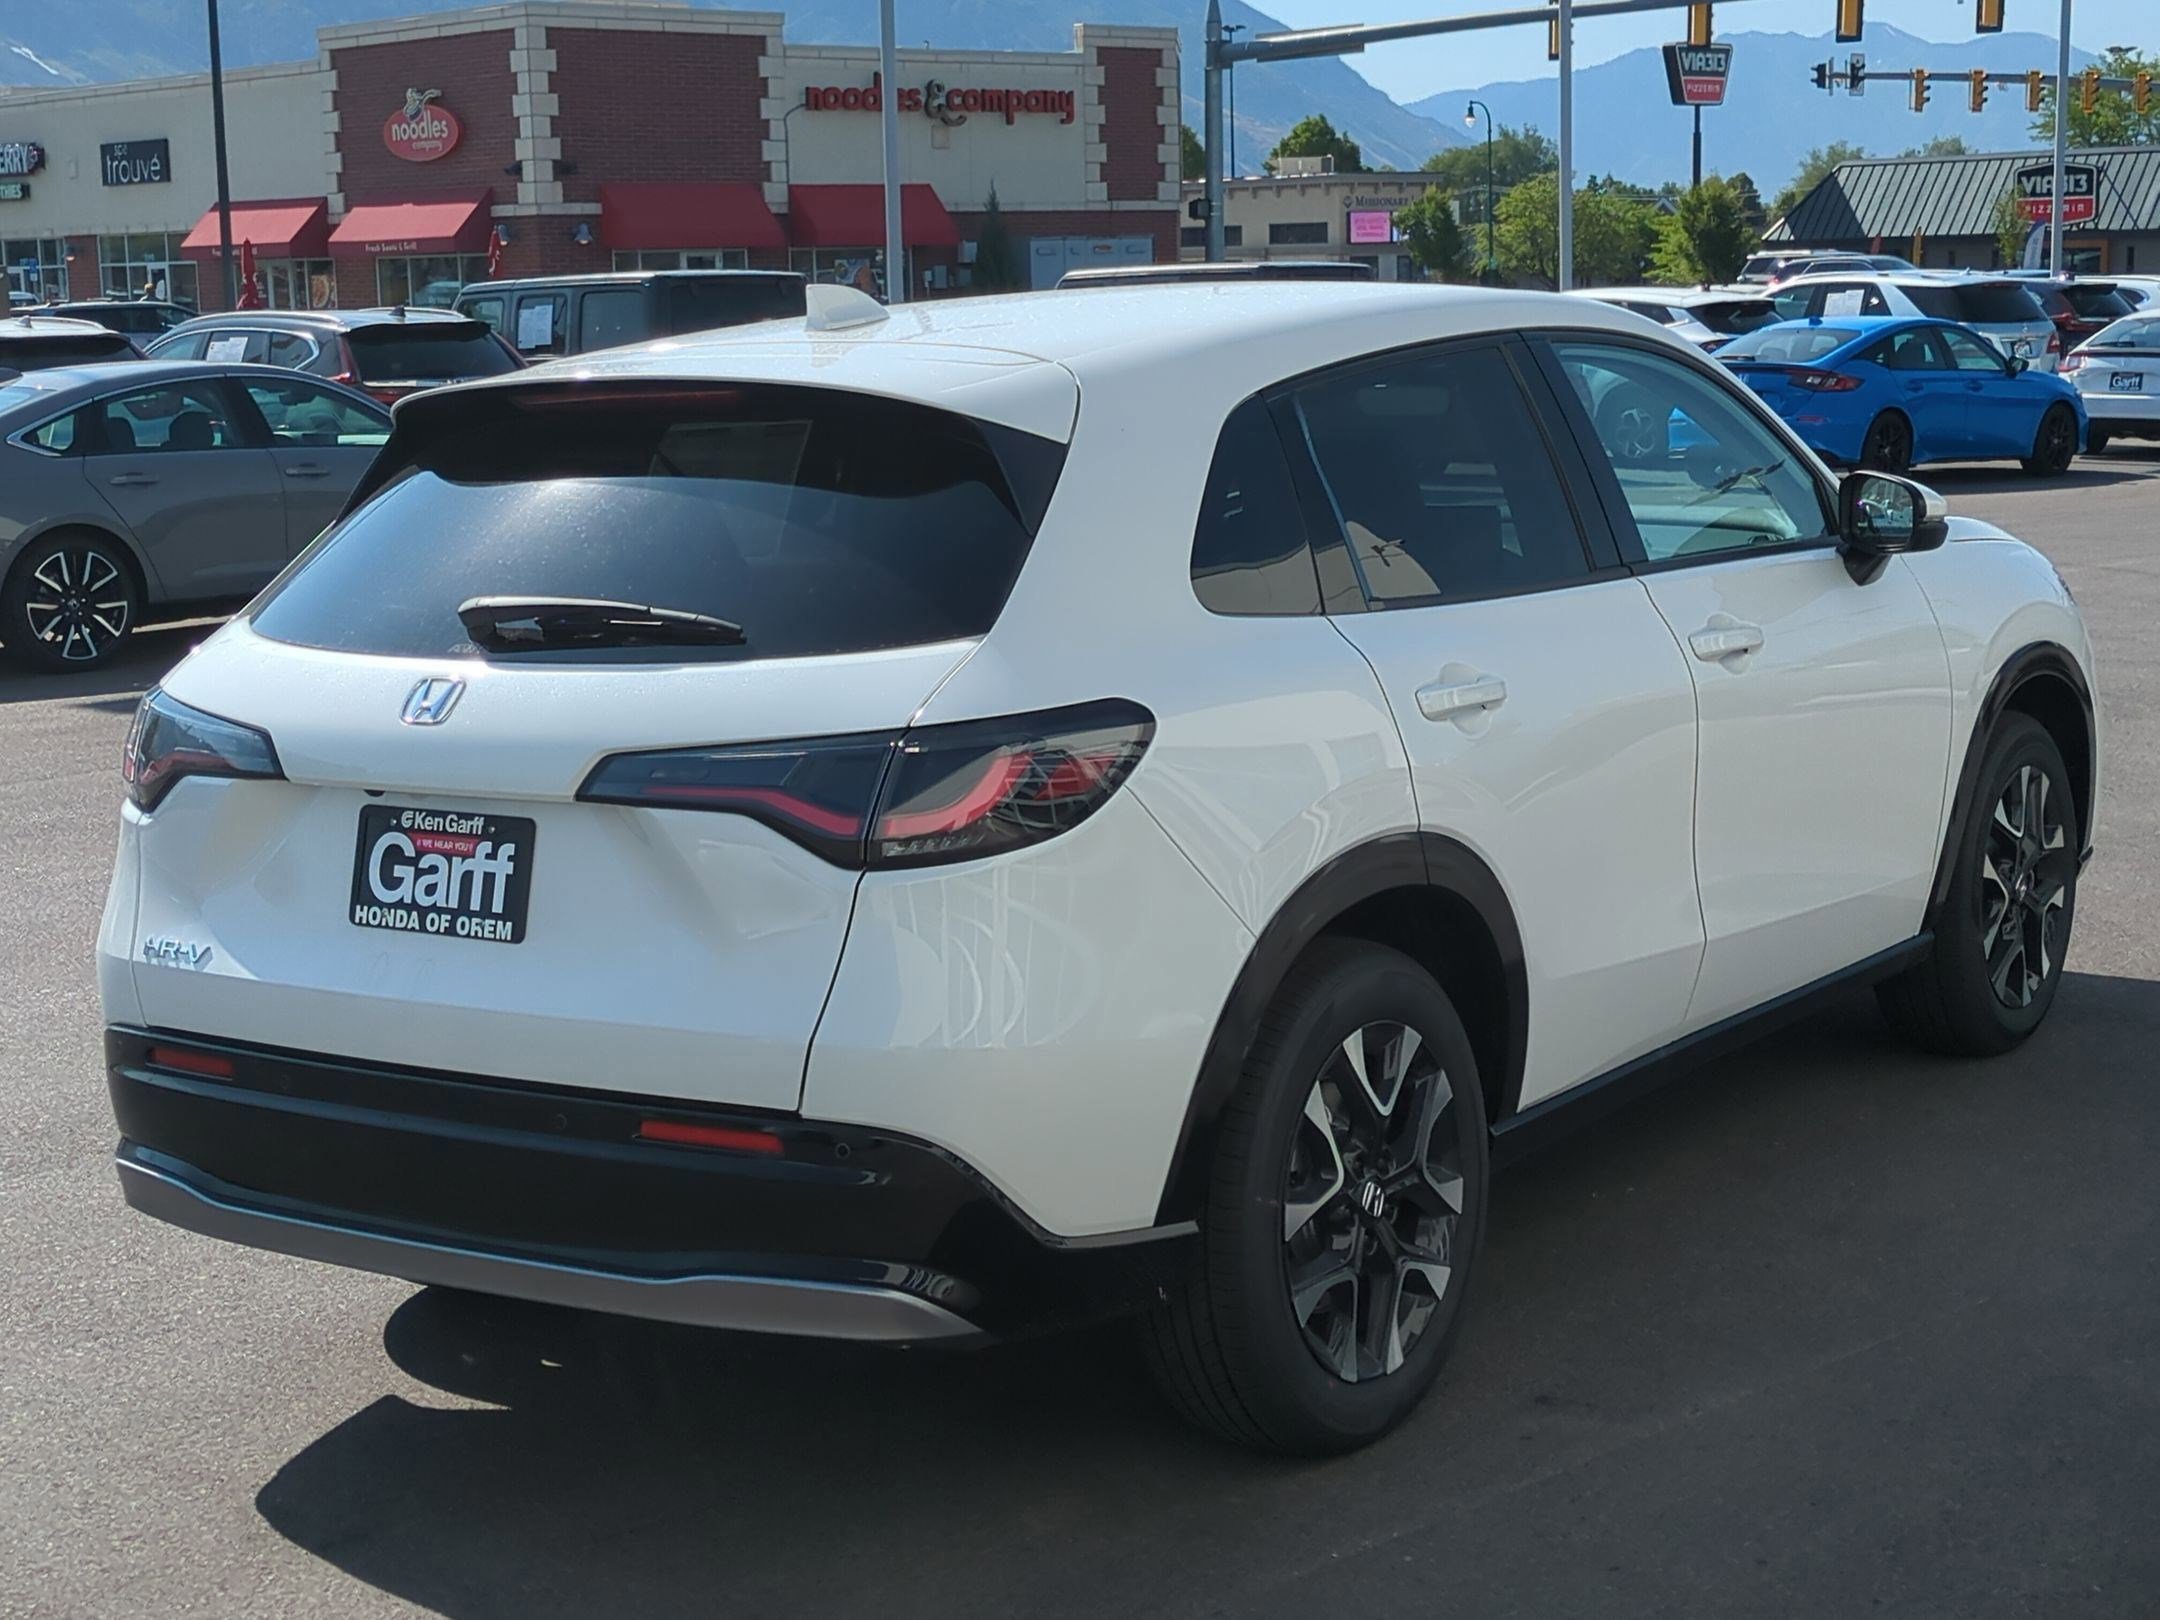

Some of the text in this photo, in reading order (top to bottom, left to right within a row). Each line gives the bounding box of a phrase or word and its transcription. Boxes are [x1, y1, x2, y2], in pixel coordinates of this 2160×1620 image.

[805, 71, 922, 112] noodes
[946, 87, 1075, 125] company
[391, 108, 449, 142] noodles
[2112, 375, 2141, 387] Garff
[414, 811, 485, 835] Ken Garff
[434, 840, 453, 850] HEAR
[369, 831, 515, 914] Garff
[355, 904, 513, 941] HONDA OF OREM
[143, 936, 212, 964] HR-V
